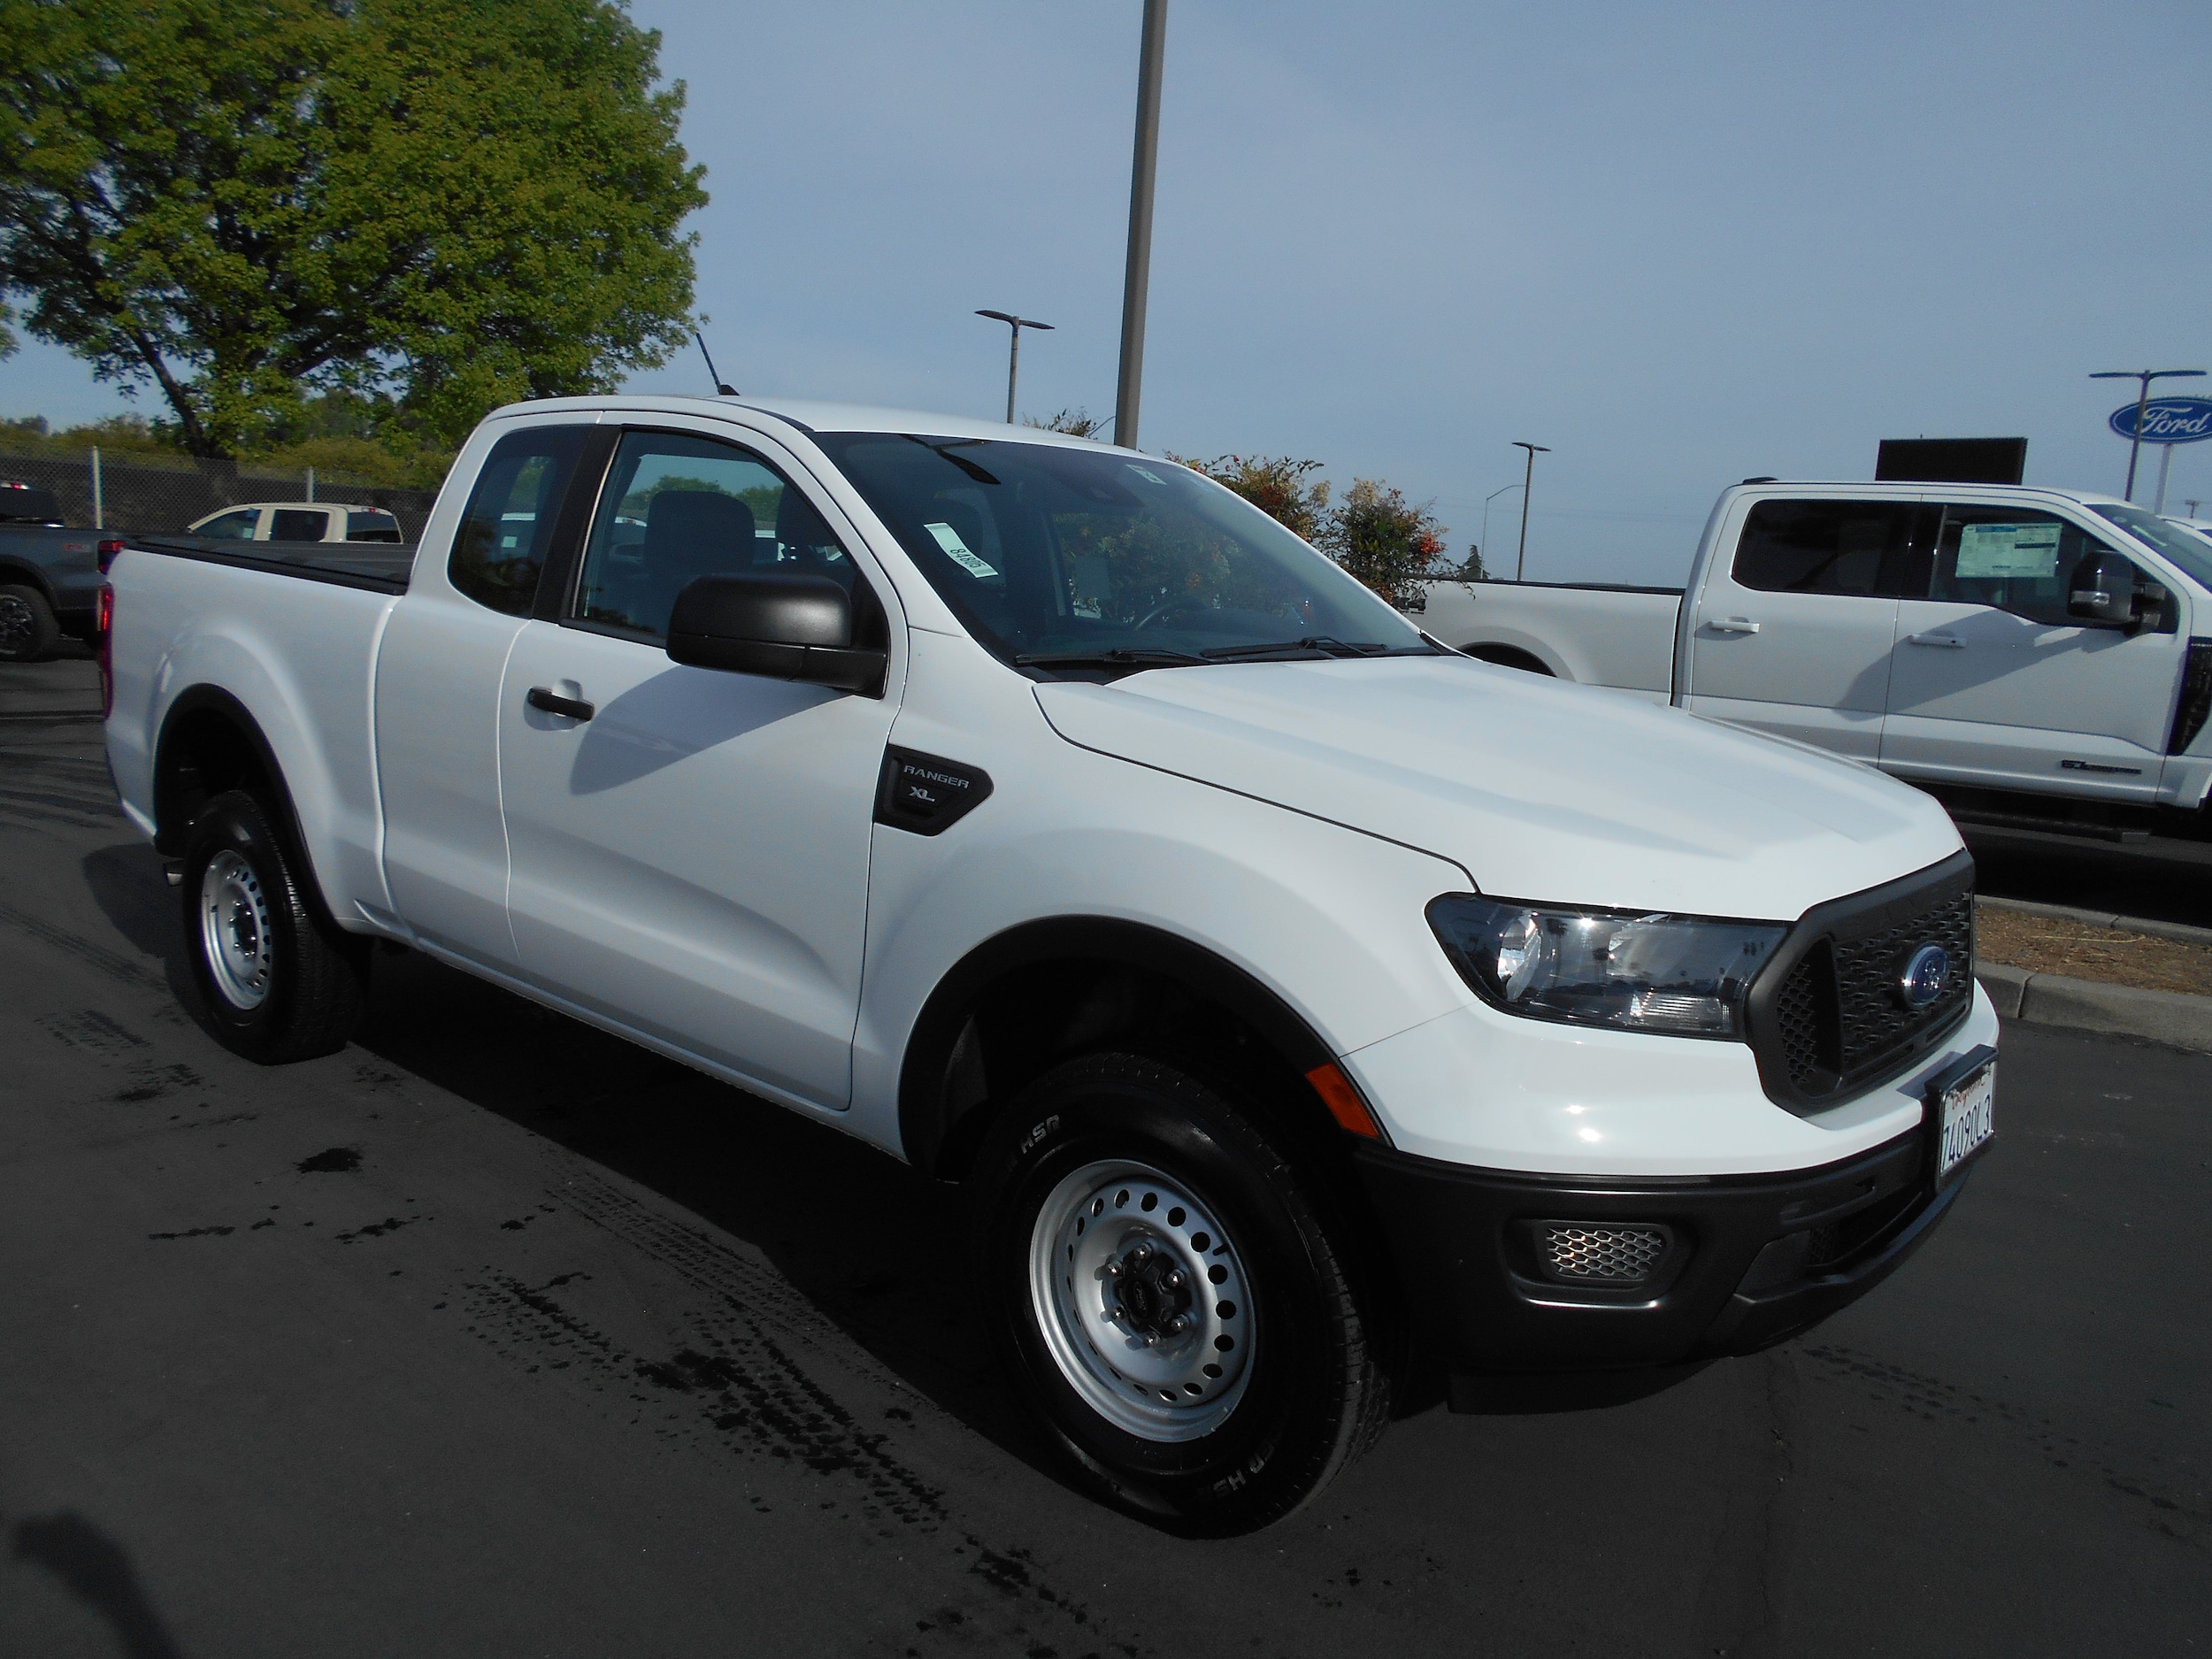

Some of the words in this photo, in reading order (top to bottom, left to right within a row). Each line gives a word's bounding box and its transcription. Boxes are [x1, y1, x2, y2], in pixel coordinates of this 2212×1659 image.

[2134, 406, 2211, 434] Ford
[902, 764, 970, 789] RANGER
[909, 786, 935, 803] XL
